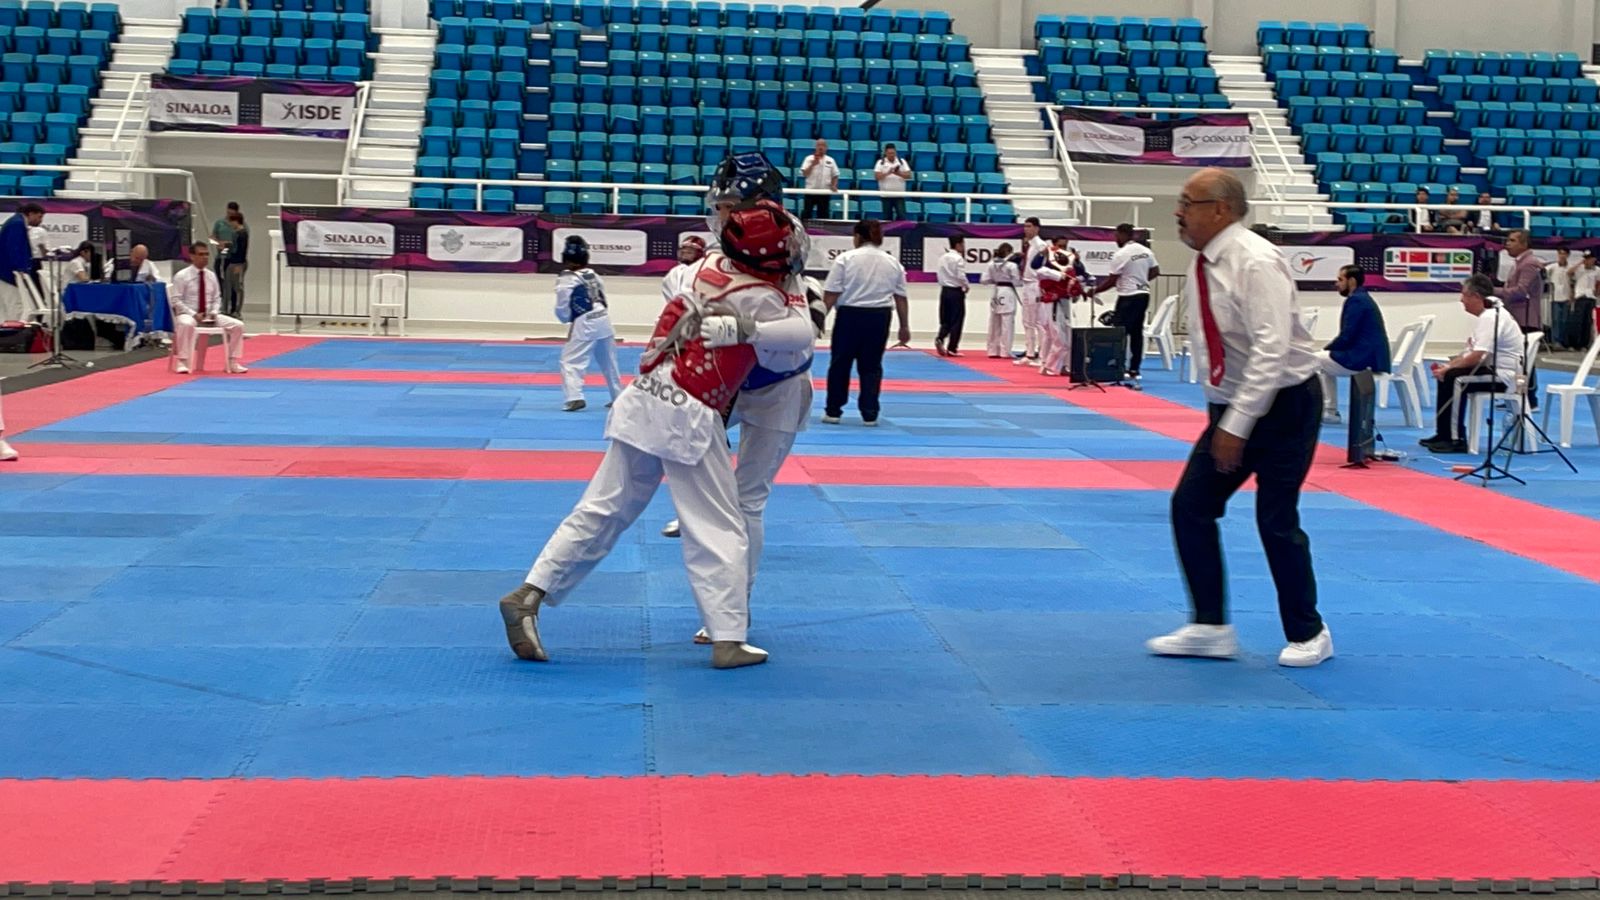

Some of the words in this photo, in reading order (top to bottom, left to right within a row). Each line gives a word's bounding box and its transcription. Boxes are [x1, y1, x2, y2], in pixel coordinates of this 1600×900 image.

[166, 102, 232, 115] SINALOA
[299, 104, 342, 120] ISDE
[324, 233, 386, 244] SINALOA
